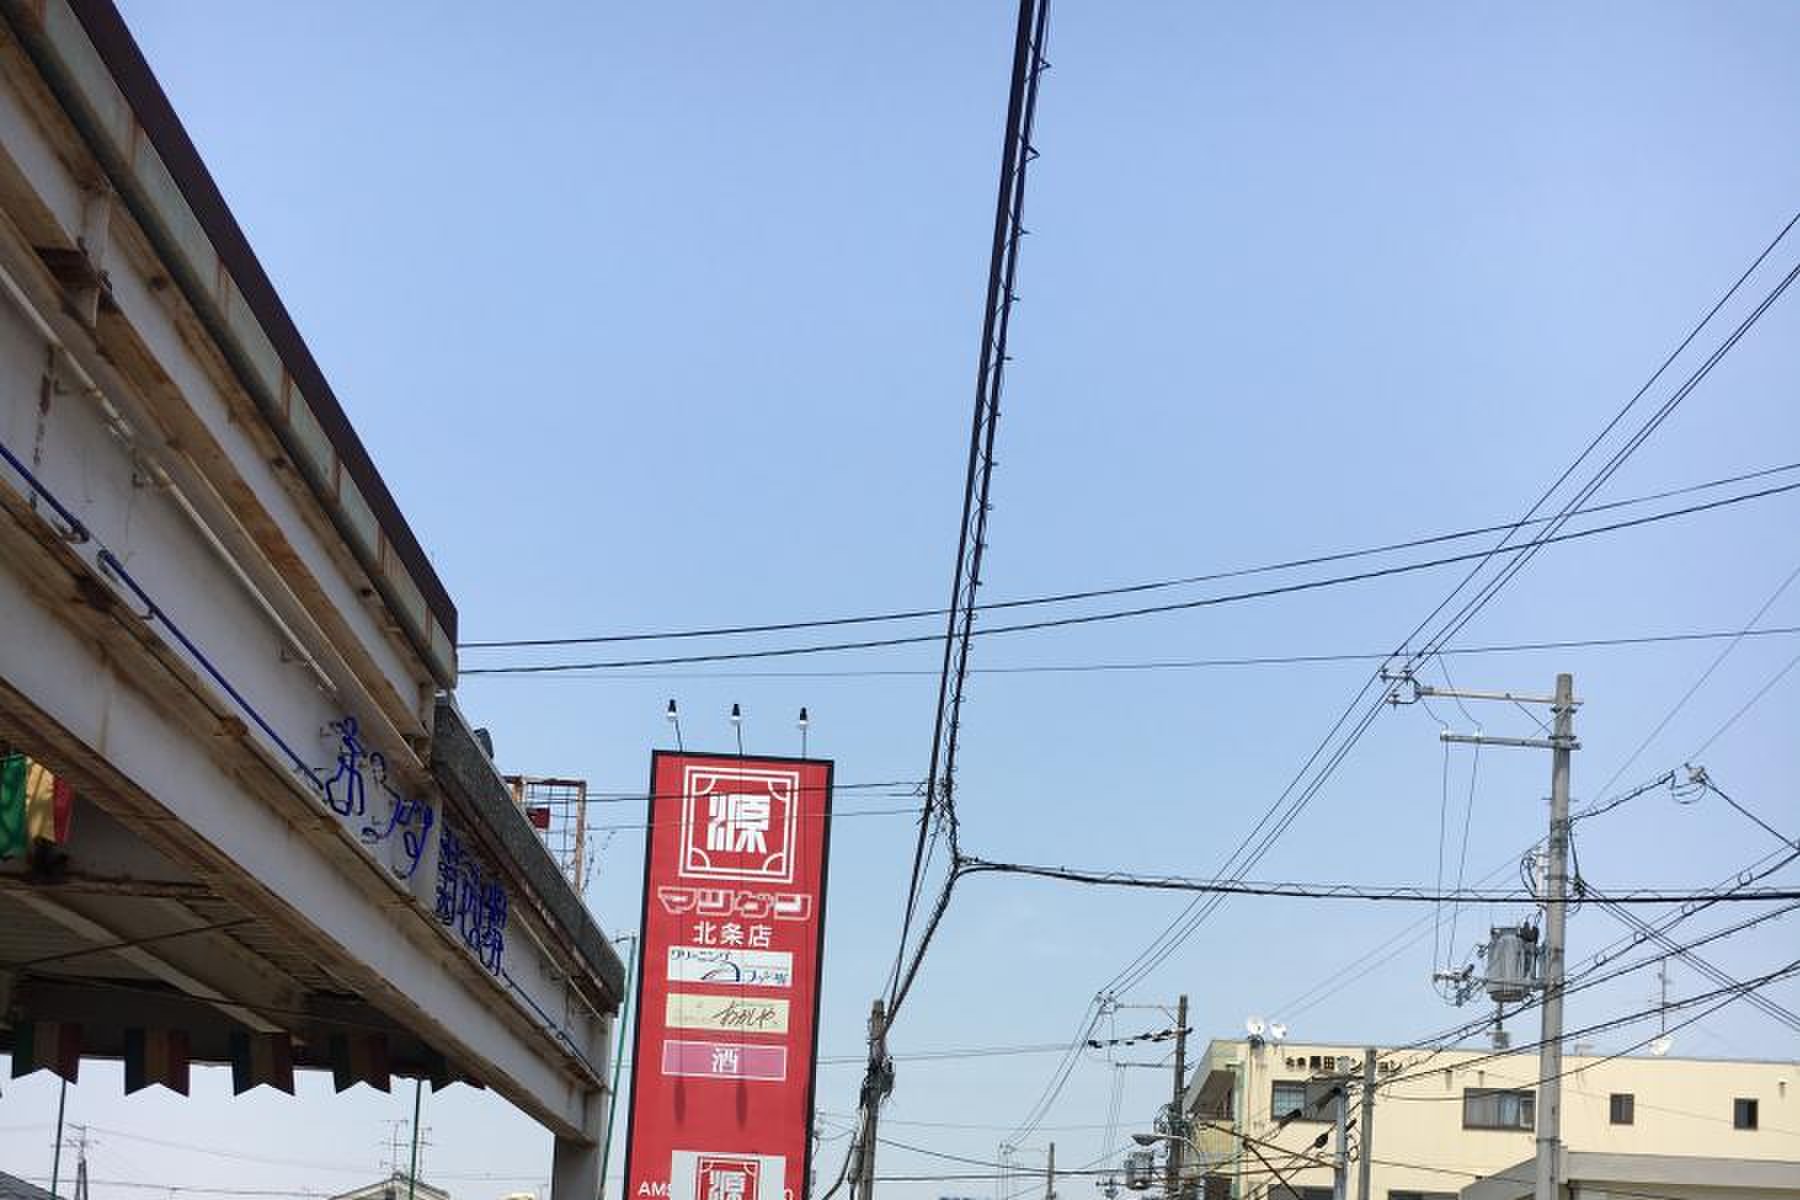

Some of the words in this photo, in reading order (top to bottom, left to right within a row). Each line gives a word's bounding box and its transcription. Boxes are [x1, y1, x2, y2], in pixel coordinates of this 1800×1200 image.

[706, 791, 771, 854] 源
[692, 921, 773, 949] 北条店
[711, 1047, 740, 1074] 酒
